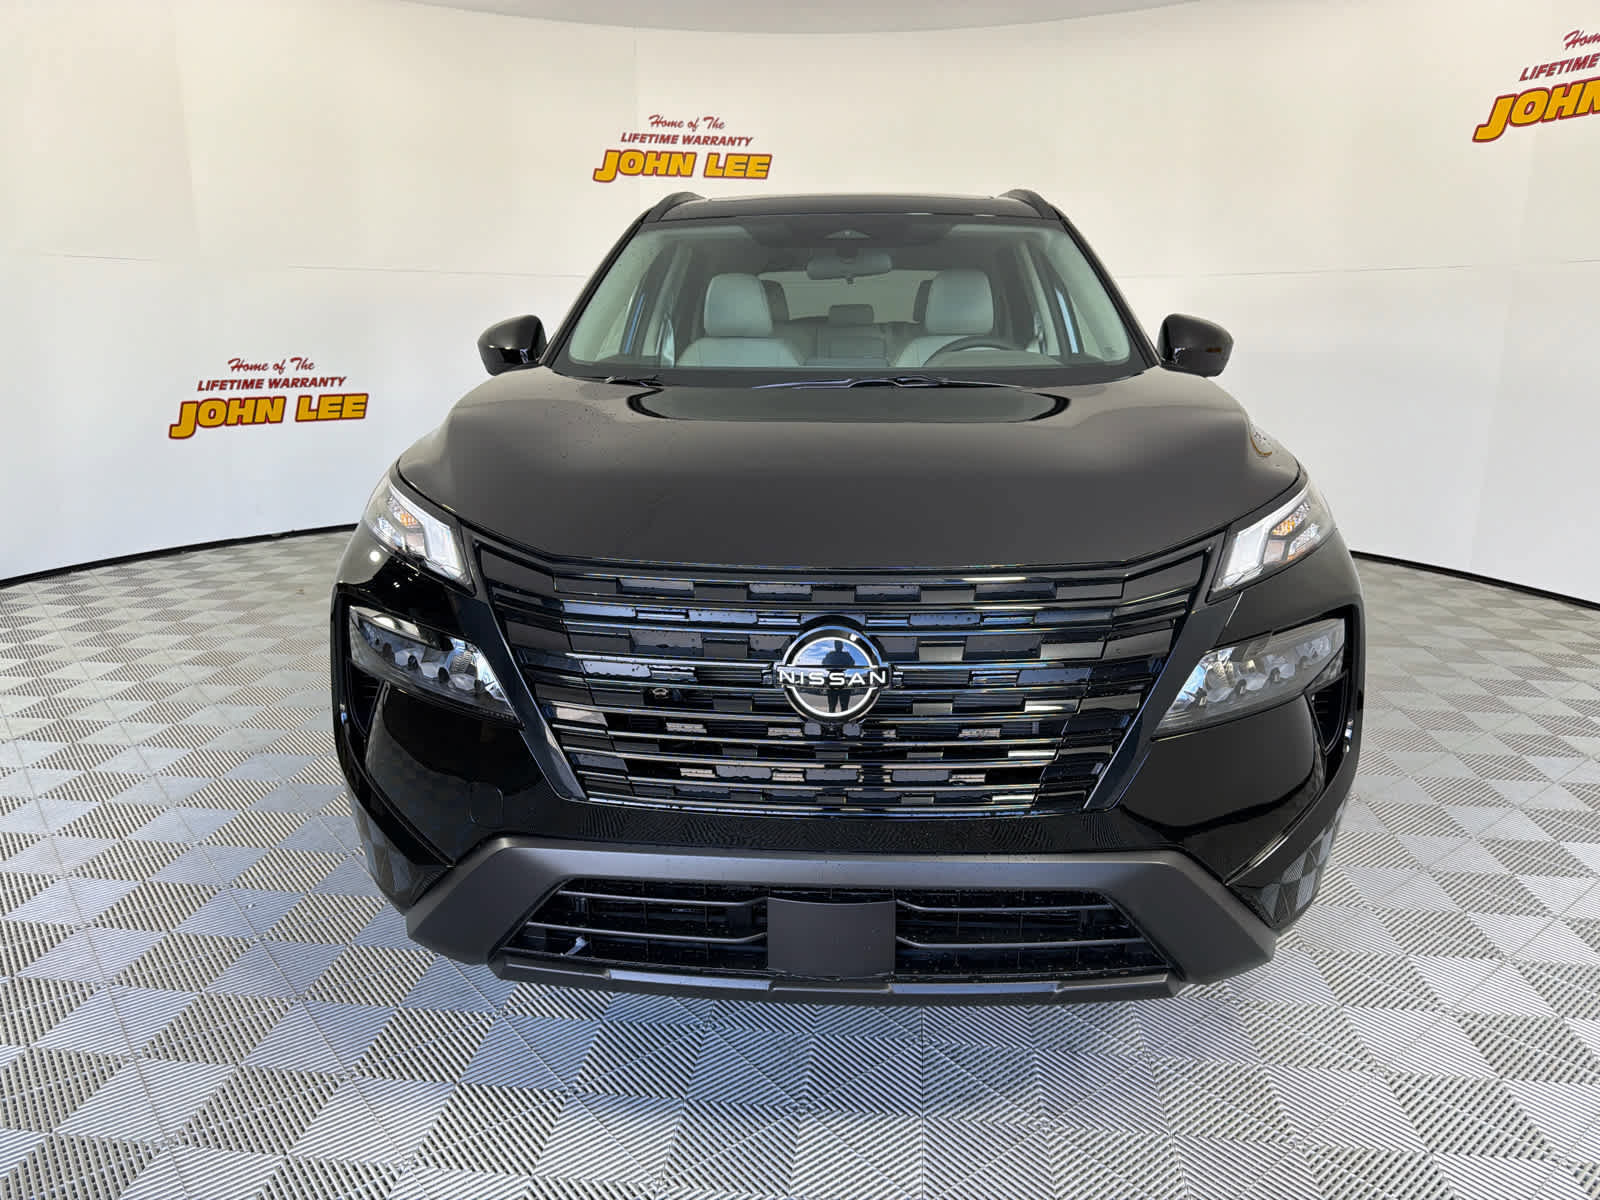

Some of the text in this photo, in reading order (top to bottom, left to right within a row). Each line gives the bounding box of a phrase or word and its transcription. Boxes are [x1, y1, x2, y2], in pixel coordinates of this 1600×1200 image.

[1563, 30, 1600, 50] Hom
[1519, 52, 1600, 81] LIFETIME
[648, 114, 725, 132] Home of The
[620, 132, 753, 147] LIFETIME WARRANTY
[593, 149, 772, 183] JOHN LEE
[228, 357, 315, 375] Home of The
[197, 376, 347, 392] LIFETIME WARRANTY
[169, 393, 369, 439] JOHN LEE
[779, 670, 886, 686] NISSAN
